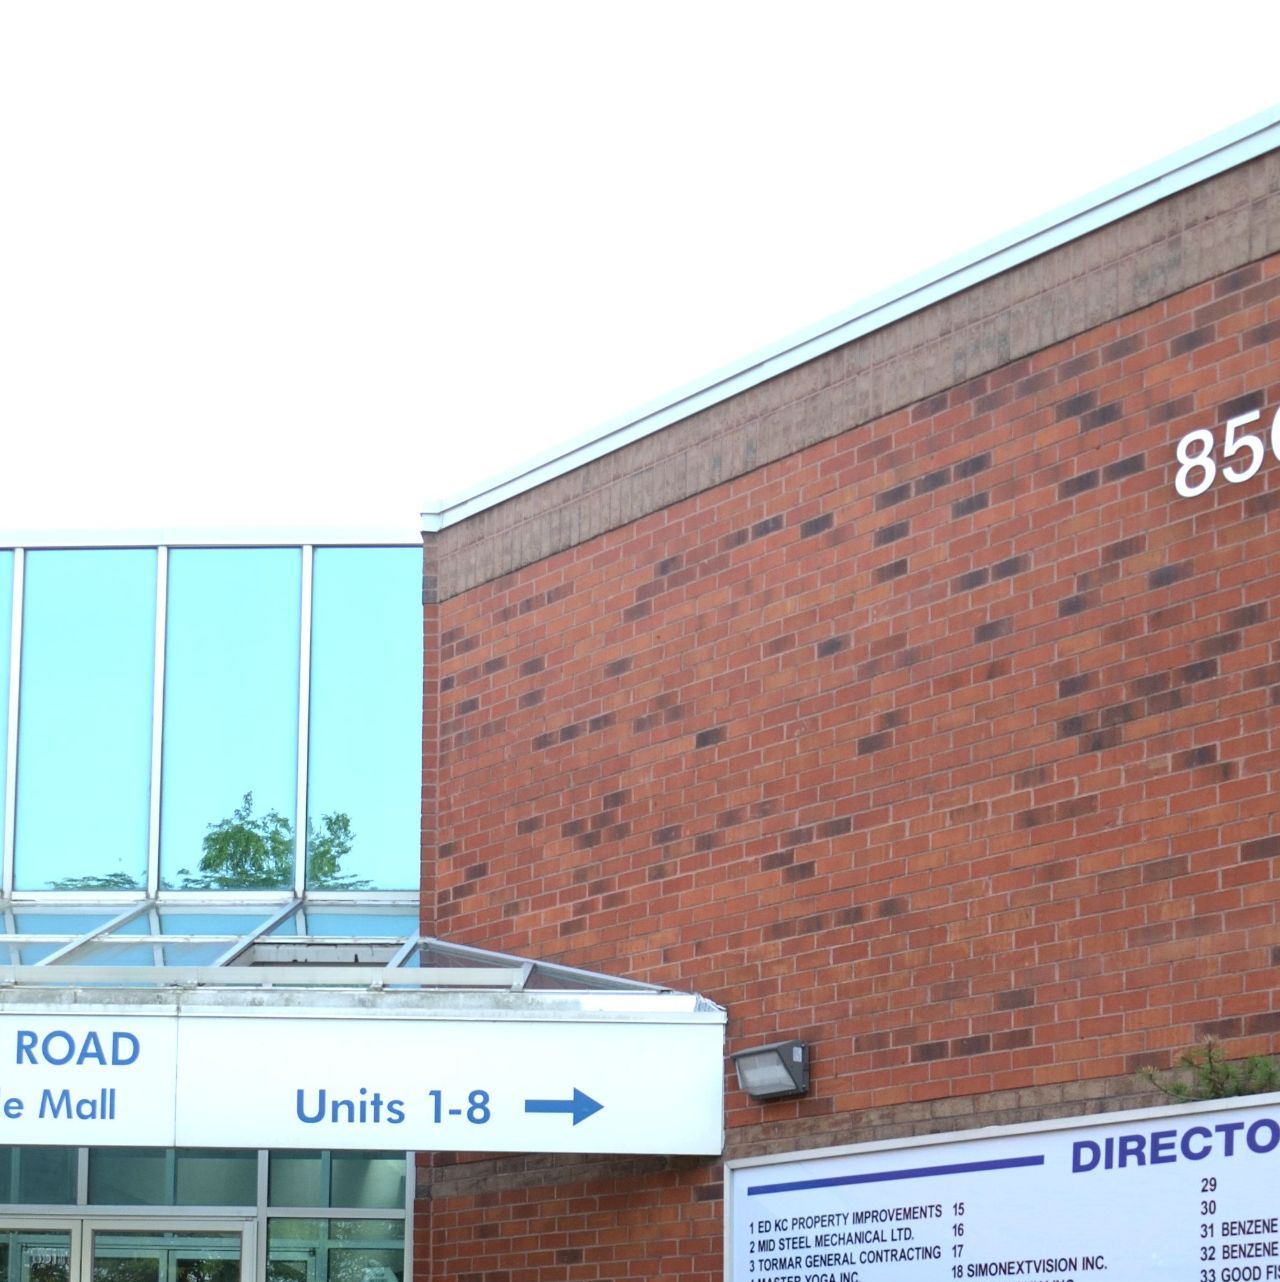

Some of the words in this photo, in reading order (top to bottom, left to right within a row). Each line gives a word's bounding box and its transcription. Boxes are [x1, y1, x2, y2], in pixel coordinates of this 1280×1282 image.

[16, 1029, 141, 1066] ROAD
[38, 1088, 116, 1120] Mall
[296, 1087, 405, 1124] Units
[427, 1089, 491, 1125] 1-8
[757, 1220, 772, 1234] ED
[773, 1218, 788, 1232] KC
[790, 1212, 849, 1230] PROPERTY
[851, 1204, 943, 1225] IMPROVEMENTS
[1221, 1218, 1278, 1237] BENZENE
[757, 1239, 776, 1252] MID
[777, 1236, 812, 1251] STEEL
[814, 1230, 888, 1247] MECHANICAL
[890, 1227, 914, 1242] LTD.
[1221, 1241, 1279, 1260] BENZENE
[757, 1256, 802, 1271] TORMAR
[804, 1252, 856, 1268] GENERAL
[858, 1245, 941, 1264] CONTRACTING
[966, 1257, 1077, 1278] SIMONEXTVISION
[1081, 1255, 1107, 1271] INC.
[1220, 1266, 1262, 1282] GOOD
